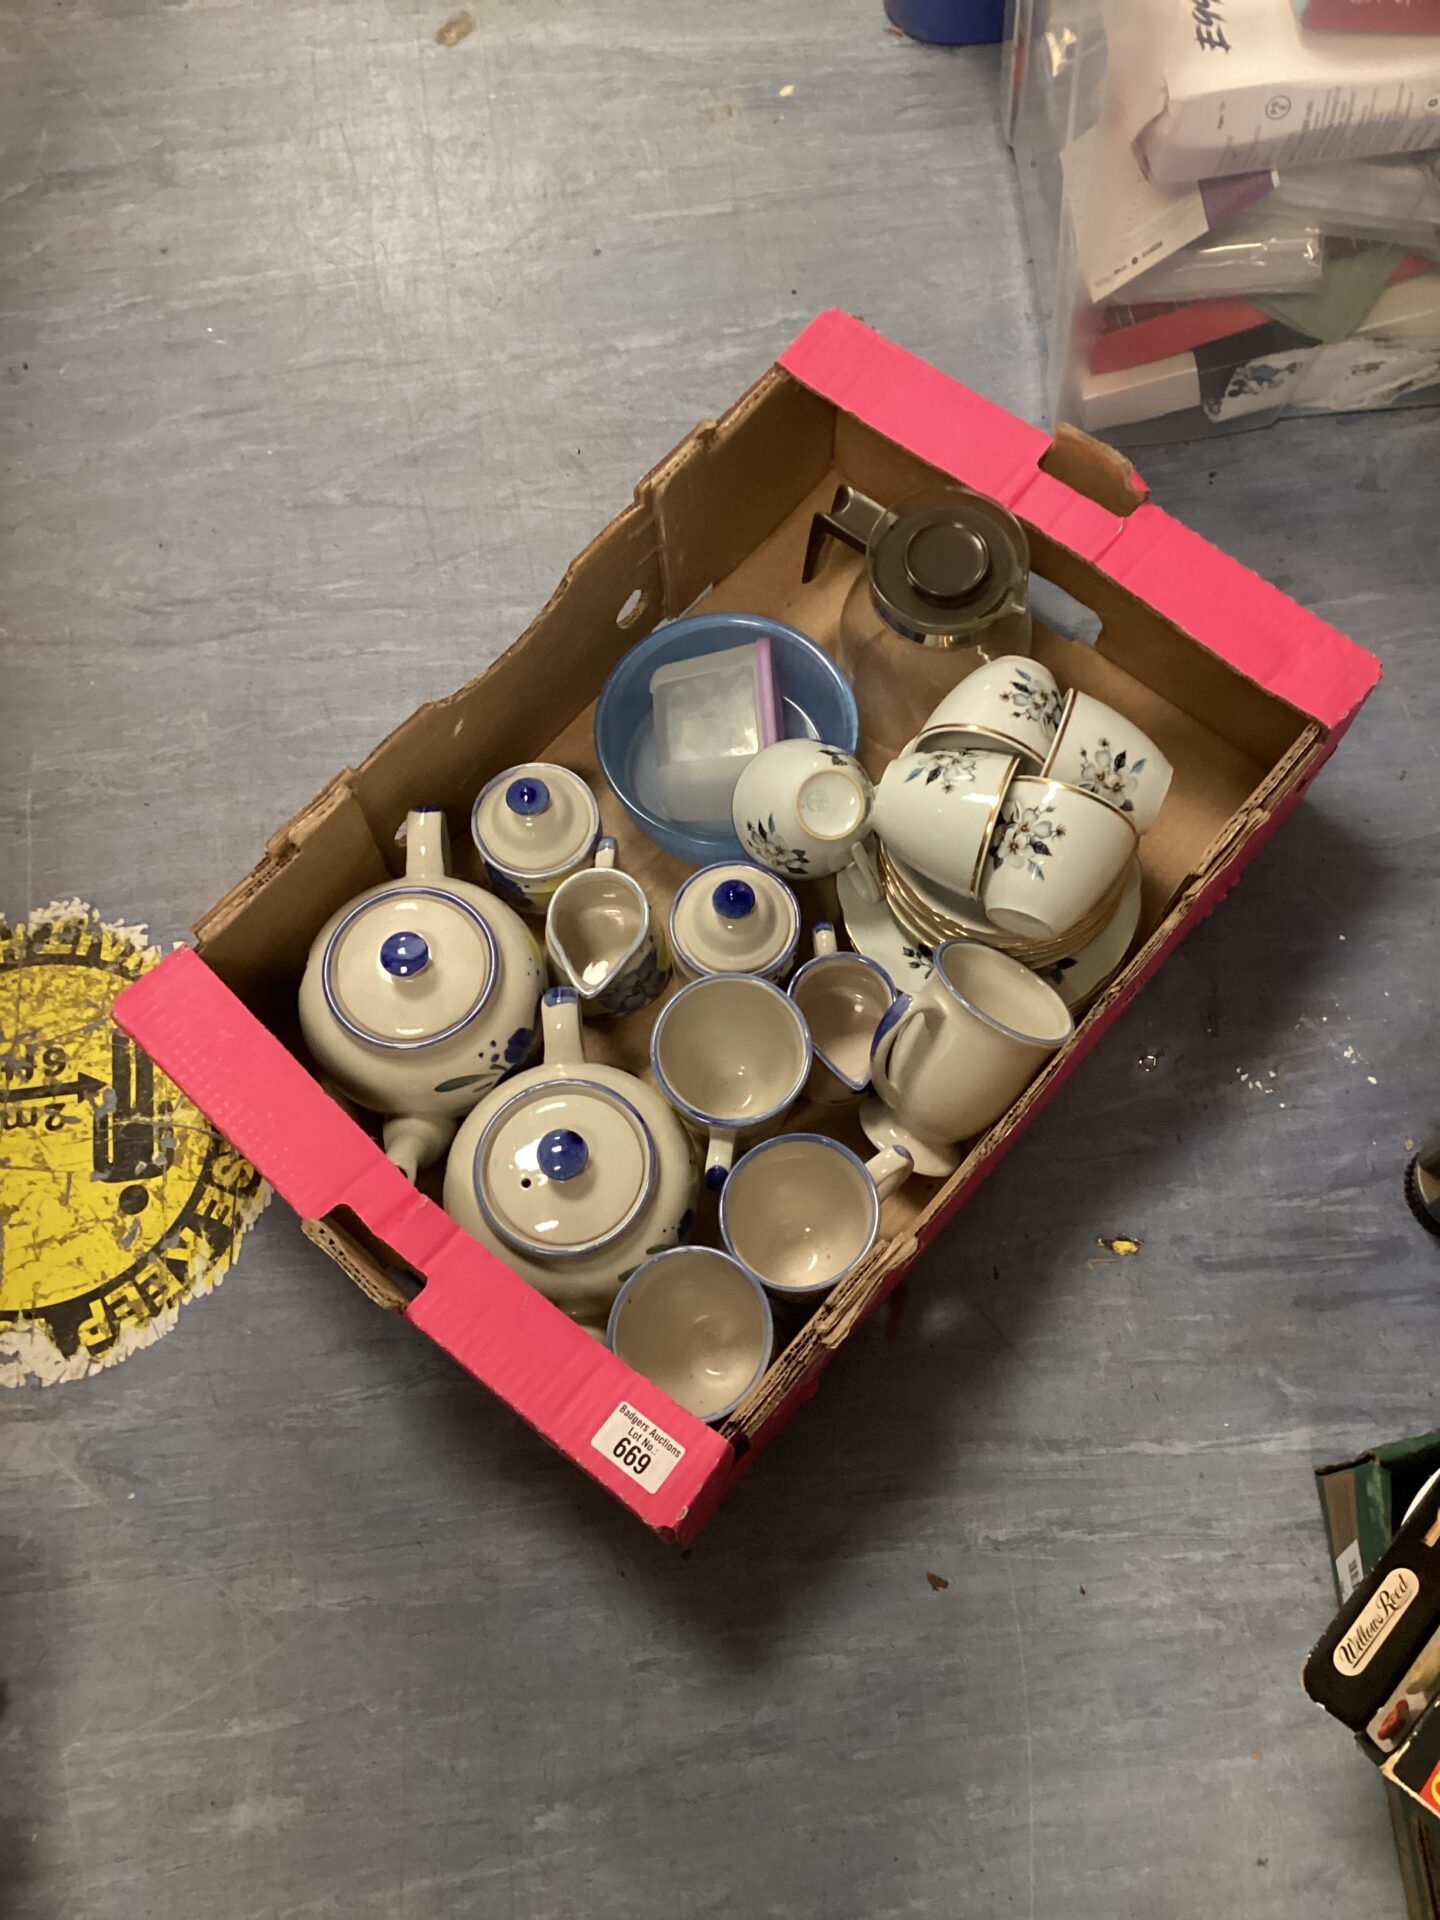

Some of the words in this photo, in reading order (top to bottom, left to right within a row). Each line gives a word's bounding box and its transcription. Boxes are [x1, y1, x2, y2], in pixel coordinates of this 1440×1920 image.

[619, 1404, 650, 1432] Badgers
[649, 1428, 682, 1458] Auctions
[627, 1427, 643, 1442] Lot
[613, 1437, 652, 1475] 669
[1375, 1573, 1410, 1617] Reed
